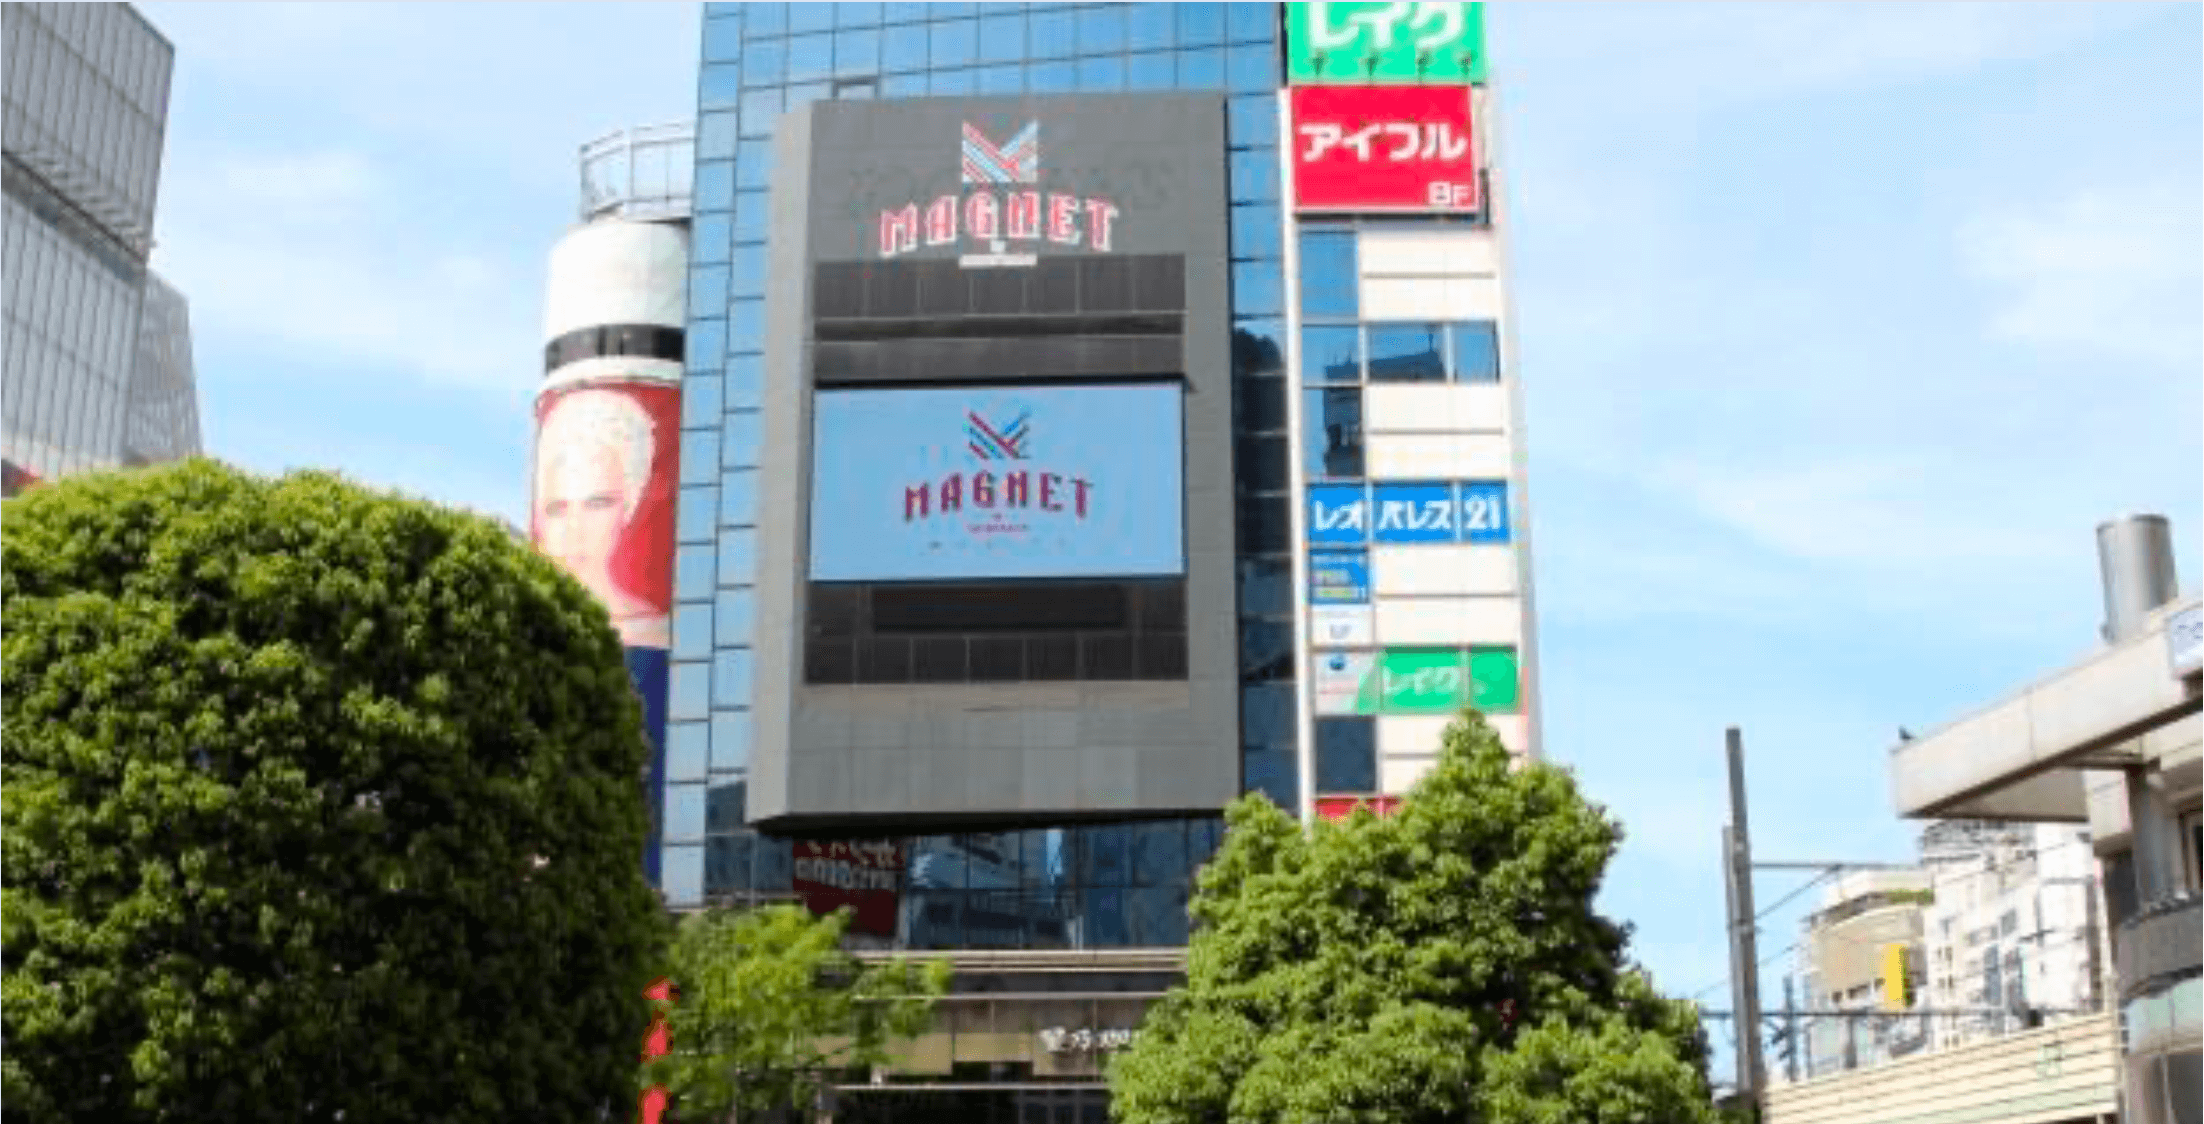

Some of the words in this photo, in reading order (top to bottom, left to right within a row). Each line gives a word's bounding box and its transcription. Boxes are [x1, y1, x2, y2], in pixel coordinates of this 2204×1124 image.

[1309, 2, 1461, 48] レイク
[1299, 122, 1467, 163] アイフル
[879, 190, 1119, 258] MAGNET
[904, 470, 1094, 524] MAGNET
[1383, 666, 1460, 696] レイク
